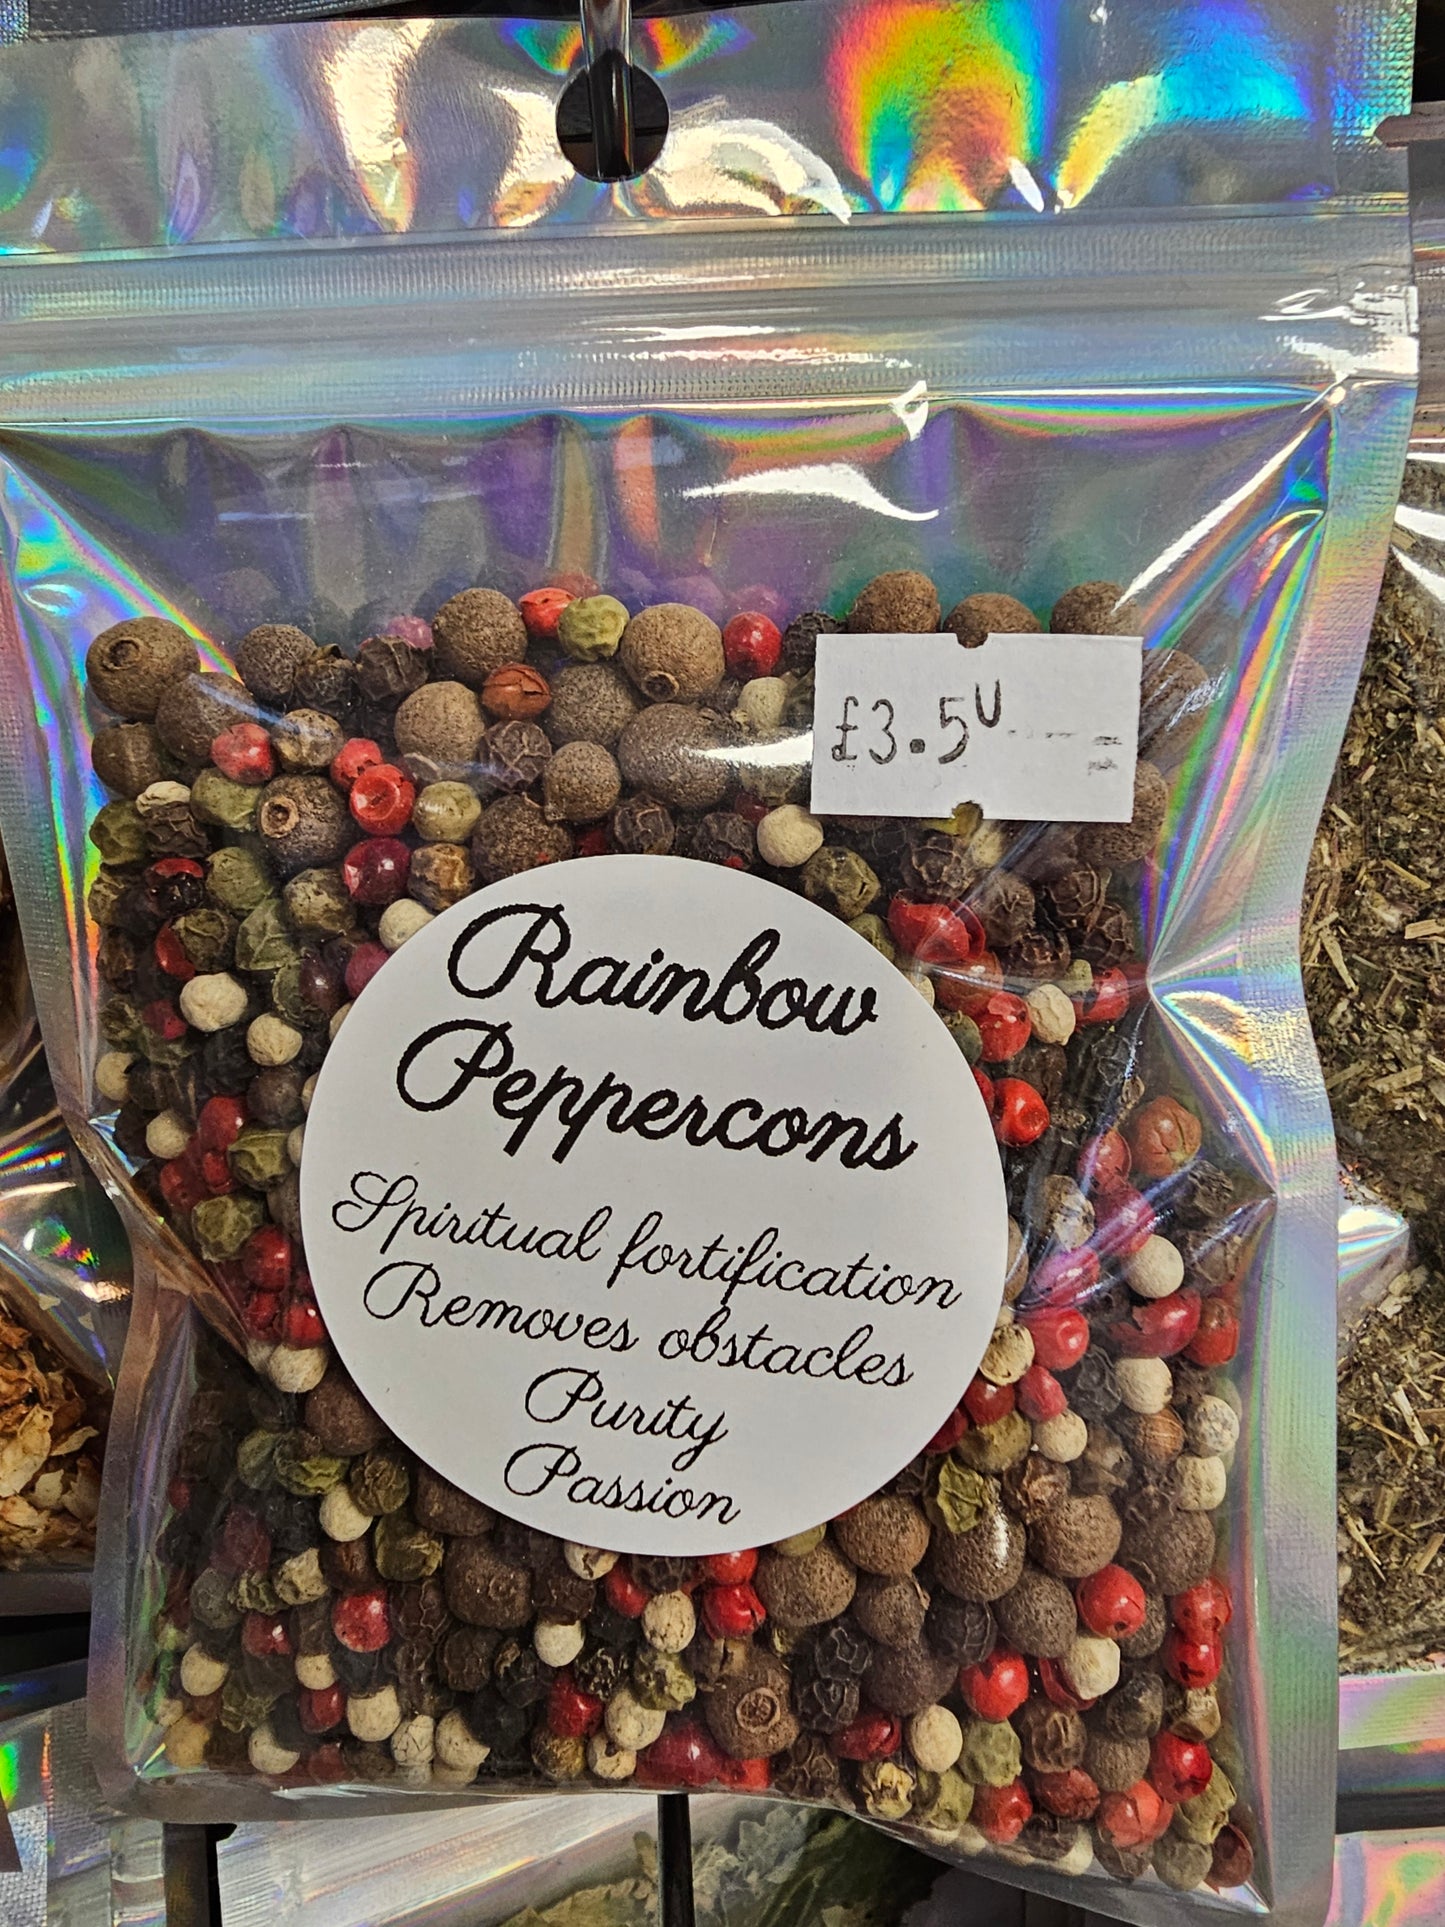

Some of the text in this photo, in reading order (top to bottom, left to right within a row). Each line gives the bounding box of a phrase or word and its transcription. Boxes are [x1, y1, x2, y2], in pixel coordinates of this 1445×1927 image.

[447, 902, 879, 1037] Rainbow
[395, 1018, 919, 1171] Peppercons
[331, 1170, 963, 1310] Spiritual fortification
[363, 1260, 915, 1387] Removes obstacles
[503, 1442, 741, 1525] Passion
[524, 1366, 729, 1472] Purity
